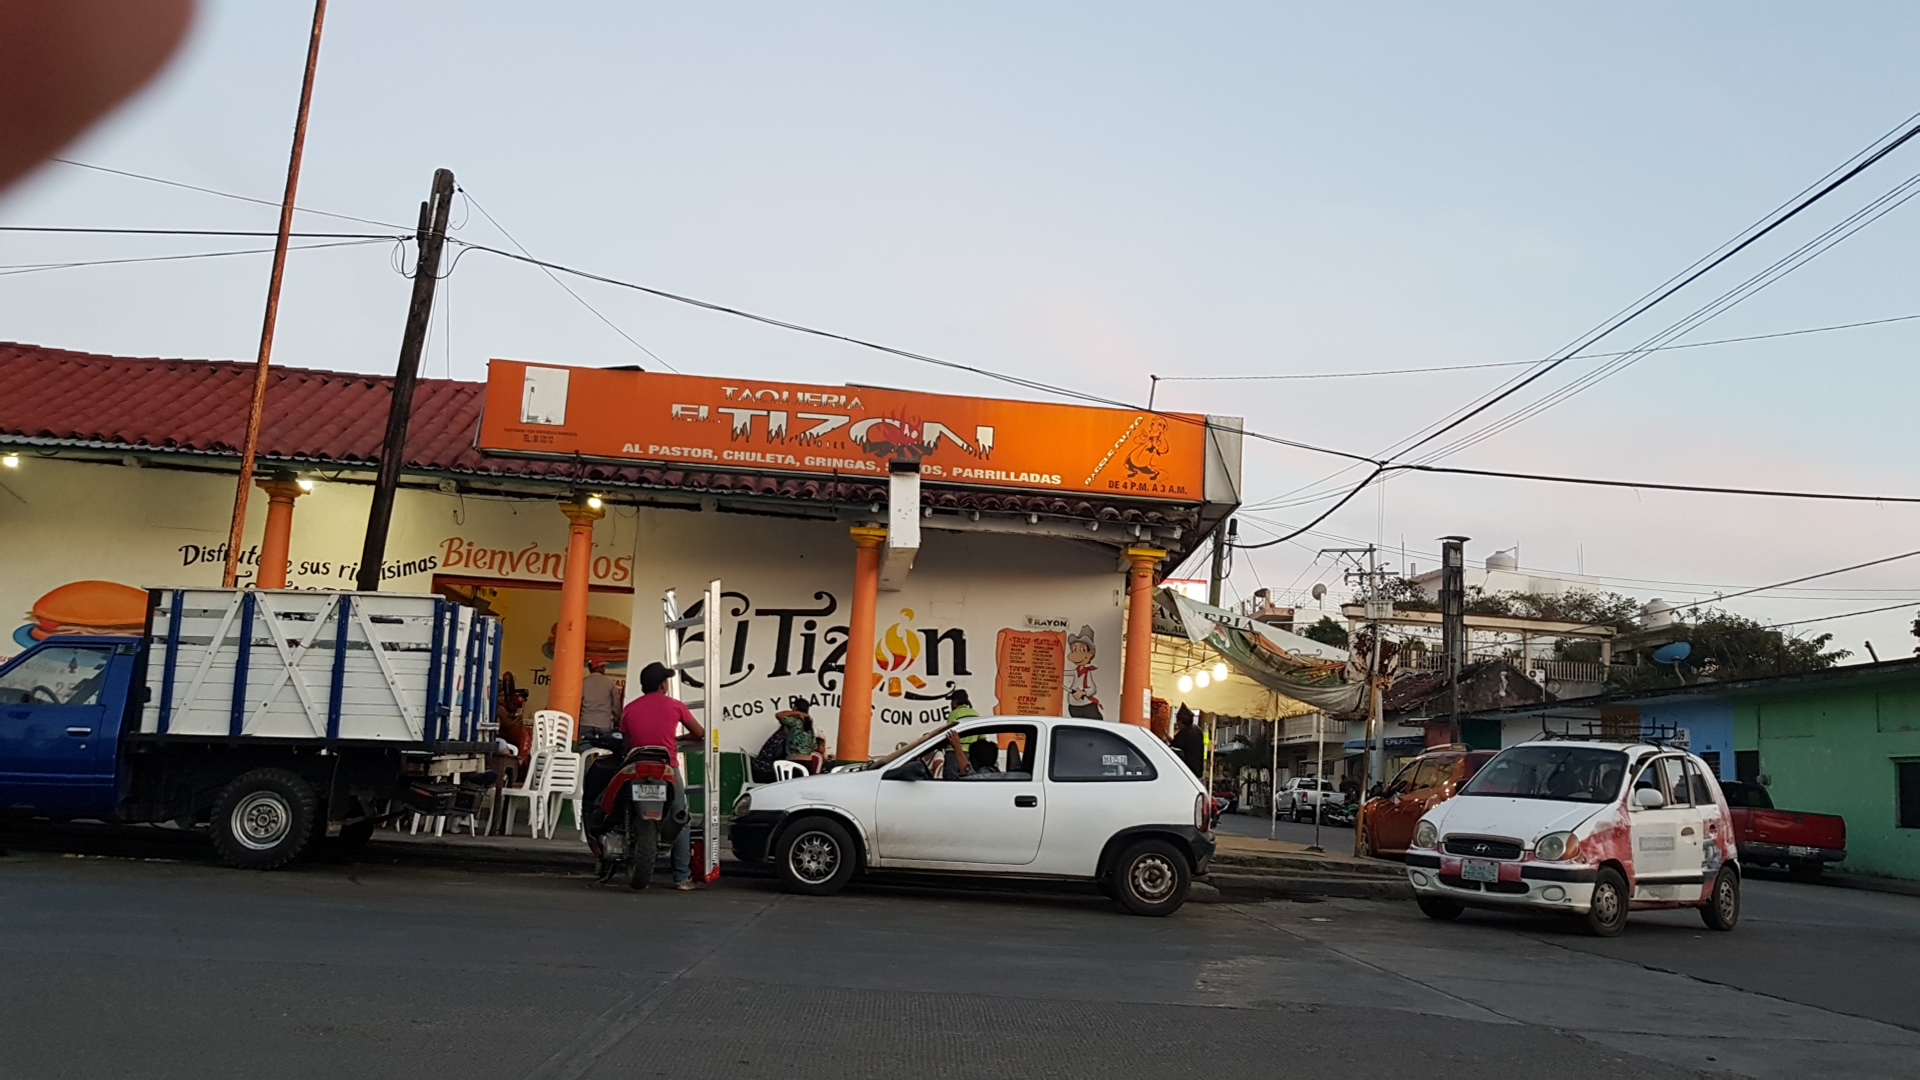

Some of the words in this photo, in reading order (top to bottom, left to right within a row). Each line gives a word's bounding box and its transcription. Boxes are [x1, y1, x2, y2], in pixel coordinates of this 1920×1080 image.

[721, 386, 866, 411] TAQUERIA
[622, 443, 644, 454] AL
[648, 444, 718, 461] PASTOR,
[723, 449, 801, 467] CHULETA,
[804, 456, 881, 473] GRINGAS,
[952, 466, 1062, 485] PARRILLADAS
[1108, 480, 1120, 490] DE
[1122, 481, 1129, 490] 4
[1130, 482, 1150, 492] P.M.
[1151, 484, 1159, 492] A
[1160, 484, 1167, 493] 3
[1168, 485, 1188, 495] A.M.
[297, 561, 331, 576] sus
[338, 555, 438, 581] riísimas
[770, 697, 782, 711] Y
[881, 708, 913, 725] CON
